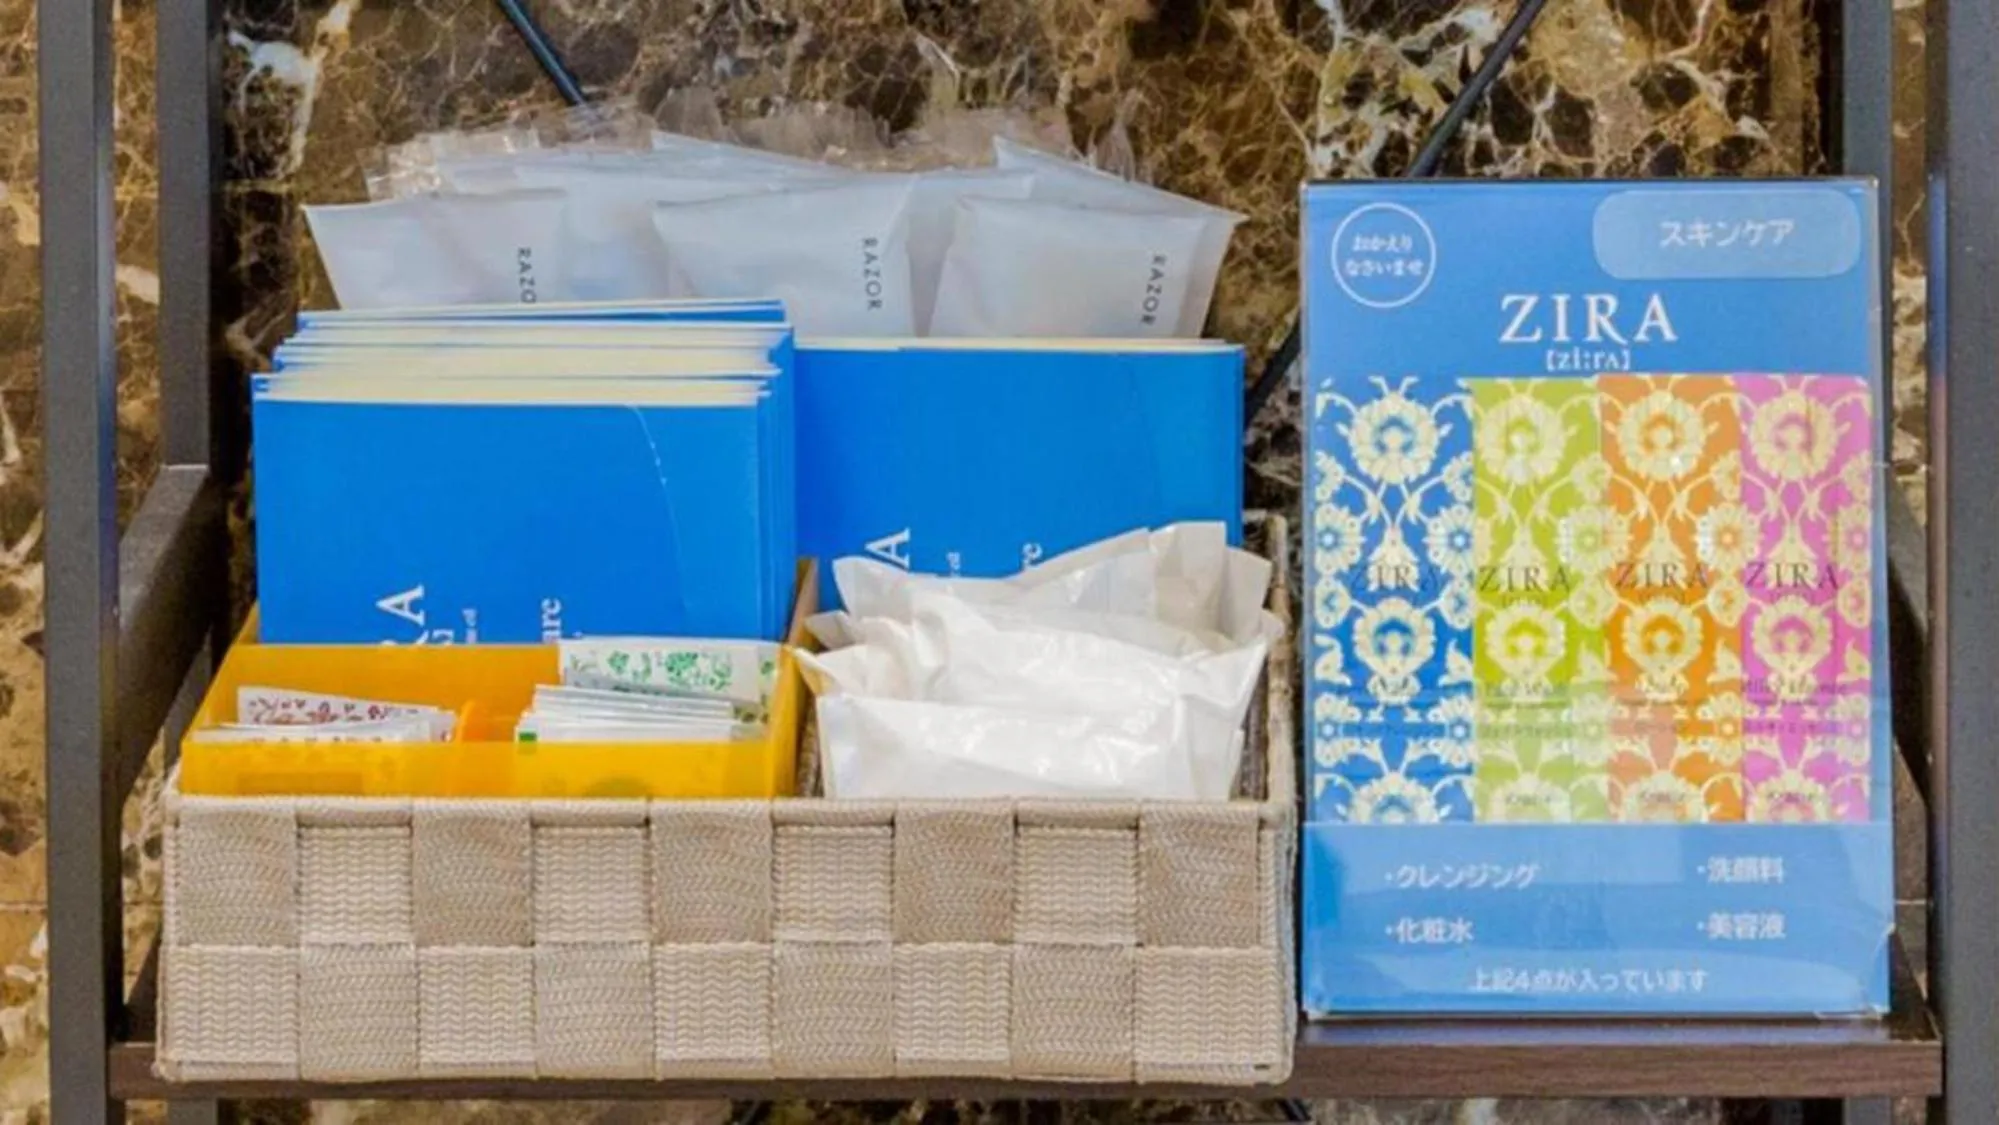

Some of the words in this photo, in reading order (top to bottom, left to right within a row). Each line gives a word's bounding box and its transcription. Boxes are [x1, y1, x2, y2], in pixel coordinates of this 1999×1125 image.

[1659, 219, 1795, 249] スキンケア
[516, 247, 538, 304] RAZO
[861, 237, 883, 311] RAZOR
[1141, 255, 1166, 326] RAZOR
[1498, 293, 1679, 345] ZIRA
[1478, 565, 1572, 592] ZIRA
[1614, 562, 1708, 589] ZIRA
[1745, 561, 1839, 589] ZIRA
